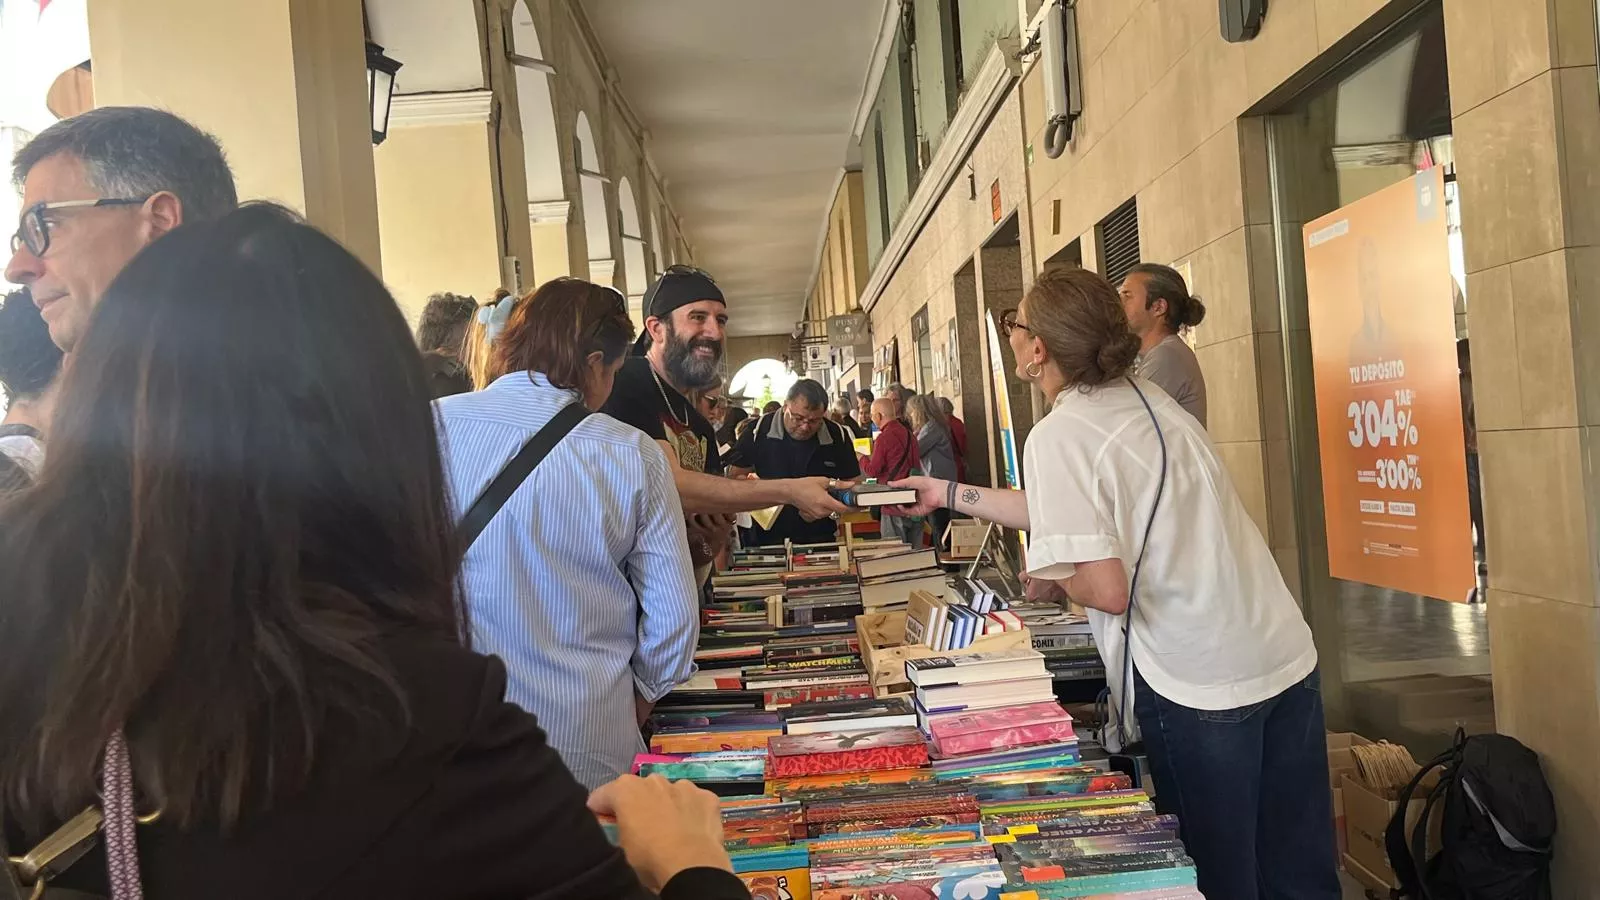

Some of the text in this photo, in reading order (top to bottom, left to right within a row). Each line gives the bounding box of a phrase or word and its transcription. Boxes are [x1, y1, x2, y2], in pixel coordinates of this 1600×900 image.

[1349, 357, 1404, 384] TU DEPÓSITO
[1031, 638, 1055, 649] COMIX
[787, 656, 852, 669] WATCHMEN
